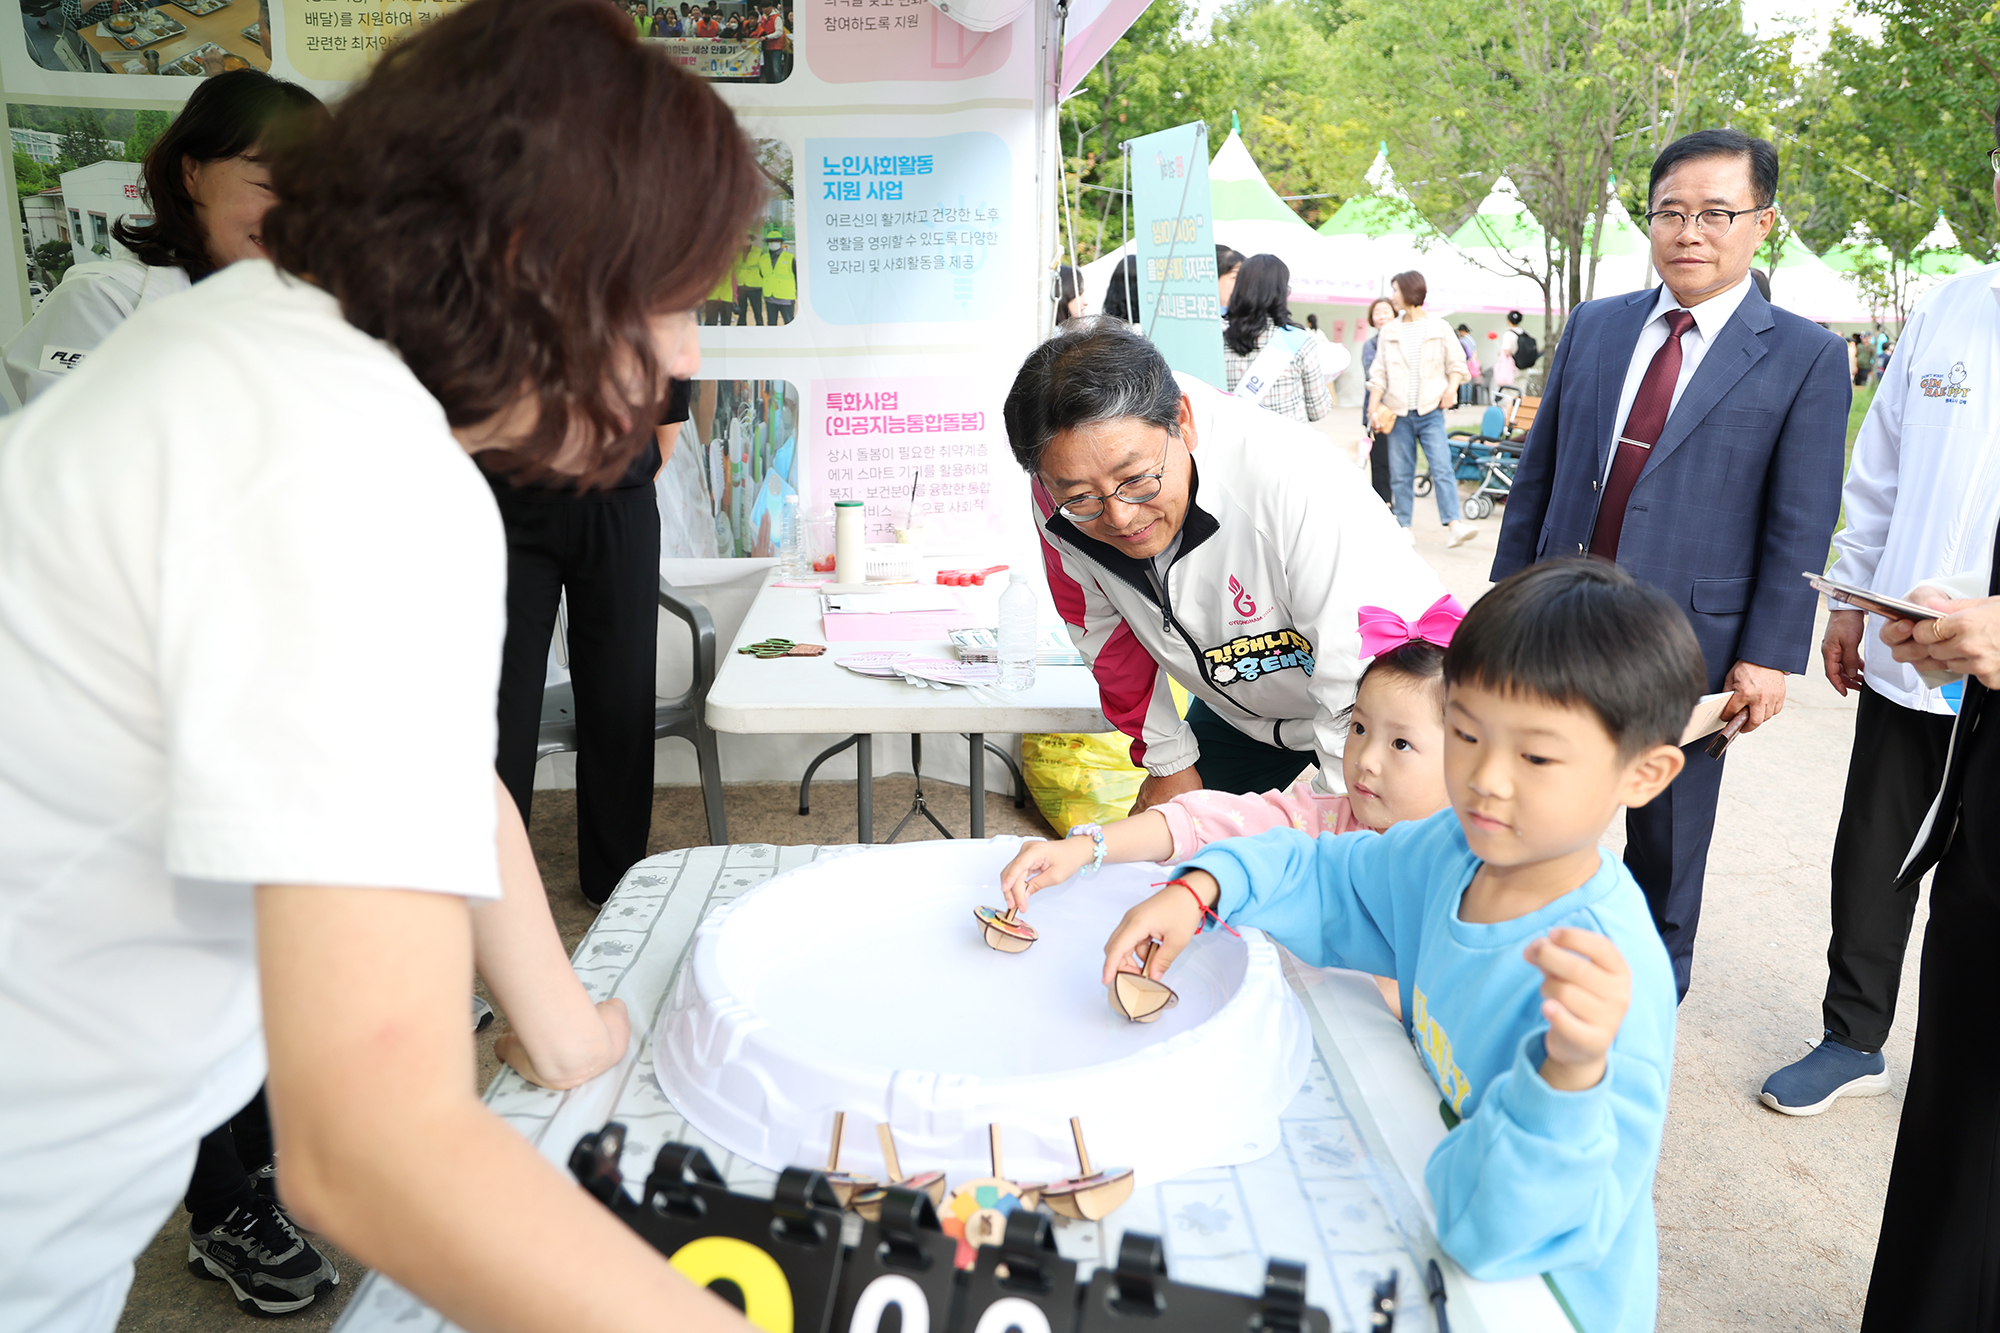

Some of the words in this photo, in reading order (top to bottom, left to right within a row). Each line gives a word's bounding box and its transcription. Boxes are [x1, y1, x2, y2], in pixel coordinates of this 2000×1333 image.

[305, 11, 353, 28] 배달)를
[357, 11, 413, 27] 지원하여
[824, 16, 890, 32] 참여하도록
[894, 14, 919, 29] 지원
[306, 36, 347, 51] 관련한
[823, 155, 934, 177] 노인사회활동
[823, 181, 861, 201] 지원
[866, 180, 903, 200] 사업
[825, 213, 877, 228] 어르신의
[881, 209, 929, 227] 활기차고
[932, 207, 970, 223] 건강한
[974, 207, 999, 222] 노후
[826, 236, 865, 252] 생활을
[868, 234, 903, 251] 영위할
[905, 233, 917, 247] 수
[920, 231, 958, 246] 있도록
[961, 230, 998, 246] 다양한
[827, 259, 865, 275] 일자리
[869, 259, 880, 273] 및
[883, 255, 945, 272] 사회활동을
[949, 254, 974, 270] 제공
[51, 351, 85, 363] FLE
[826, 391, 898, 411] 특화사업
[826, 411, 985, 436] (인공지능통합돌봄)
[827, 448, 852, 463] 상시
[856, 447, 894, 462] 돌봄이
[898, 445, 935, 460] 필요한
[939, 443, 988, 458] 취약계층
[828, 467, 853, 482] 에게
[857, 466, 895, 480] 스마트
[899, 464, 935, 478] 기기를
[939, 462, 988, 477] 활용하여
[829, 486, 853, 500] 복지
[930, 482, 965, 497] 융합한
[967, 481, 991, 495] 통합
[948, 499, 984, 514] 사회적
[871, 523, 896, 536] 구축
[1229, 616, 1263, 626] GYEONGNAM
